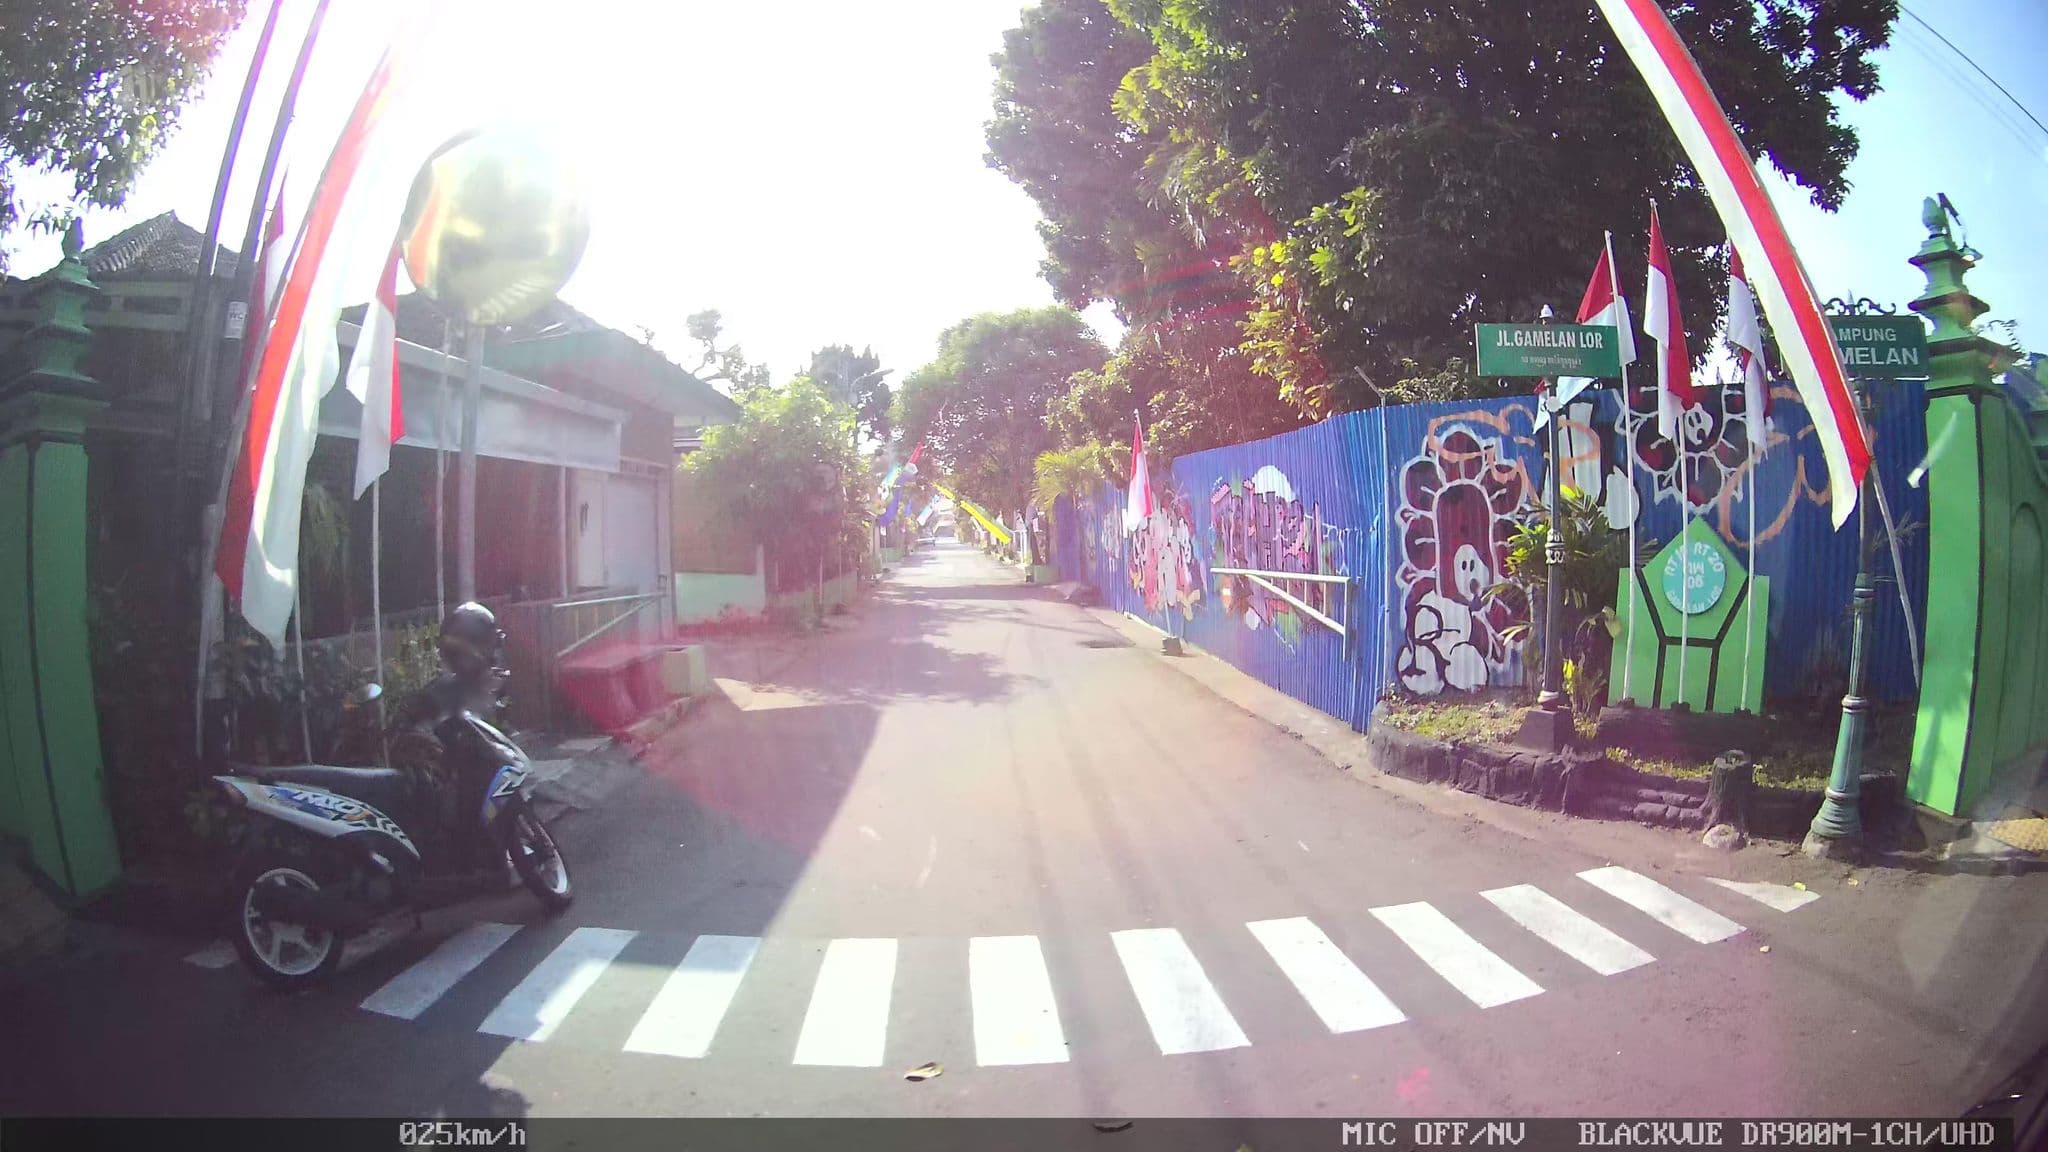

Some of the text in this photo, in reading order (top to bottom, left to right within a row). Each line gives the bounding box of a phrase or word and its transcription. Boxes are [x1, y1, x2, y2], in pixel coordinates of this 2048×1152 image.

[1496, 330, 1603, 349] JL.GAMELAN LOR
[1841, 347, 1919, 366] MELAN
[1694, 541, 1711, 556] RT
[1707, 552, 1724, 572] 20
